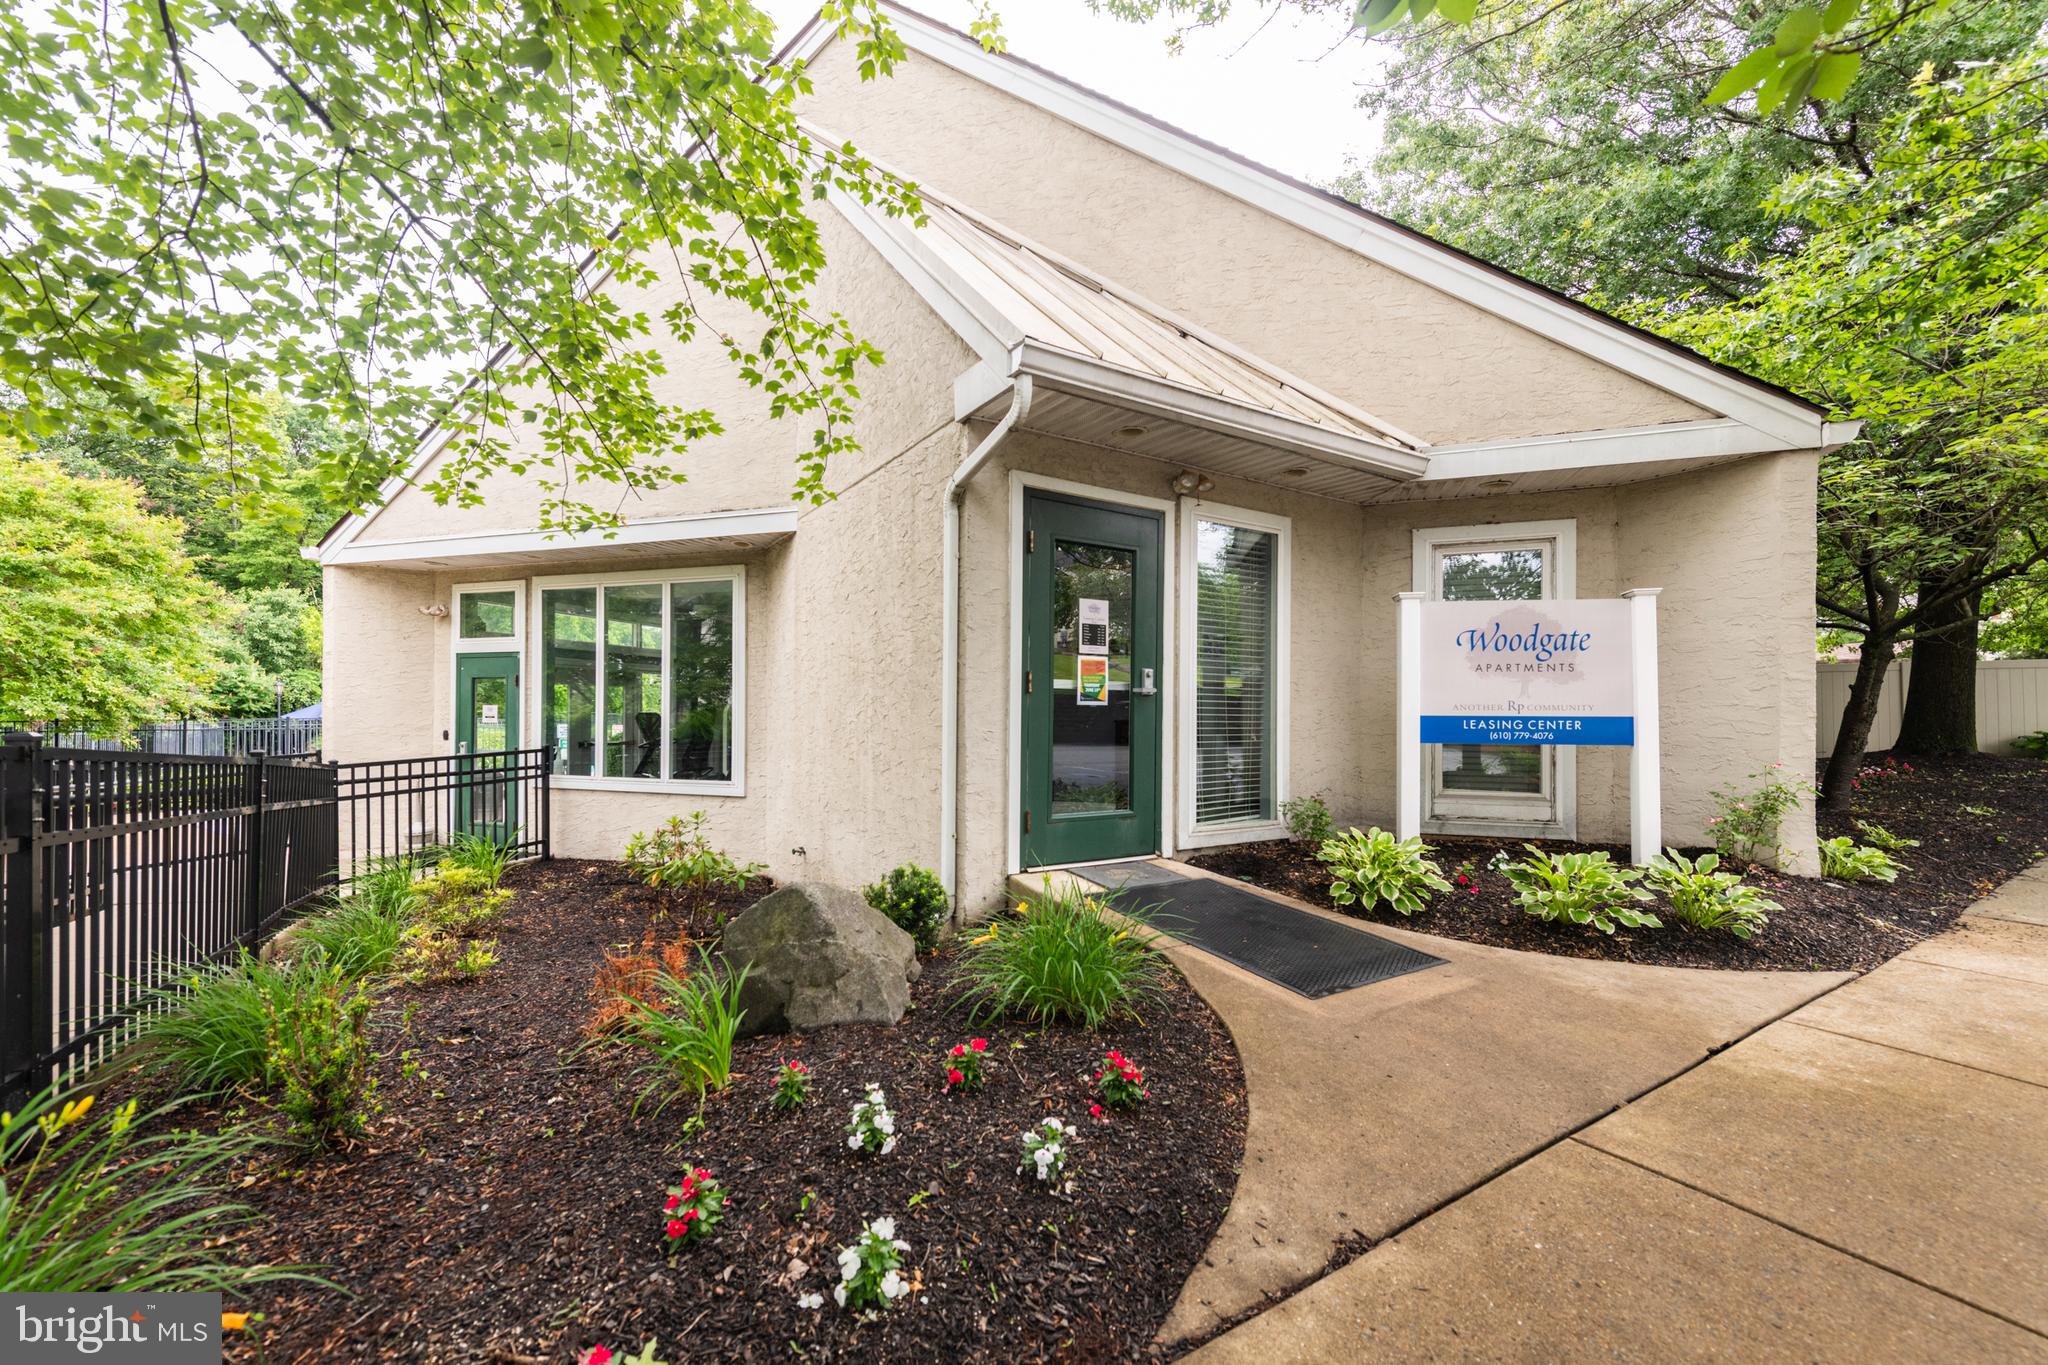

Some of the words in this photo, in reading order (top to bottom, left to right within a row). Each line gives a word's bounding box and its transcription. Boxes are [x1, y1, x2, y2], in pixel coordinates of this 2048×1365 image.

[1456, 622, 1591, 662] Woodgate
[1474, 663, 1575, 673] APARTMENTS
[1452, 703, 1504, 712] ANOTHER
[1526, 703, 1595, 712] COMMUNITY
[1463, 719, 1524, 730] LEASING
[1527, 719, 1582, 731] CENTER
[1489, 731, 1512, 741] (610)
[1513, 731, 1554, 740] 779-4076
